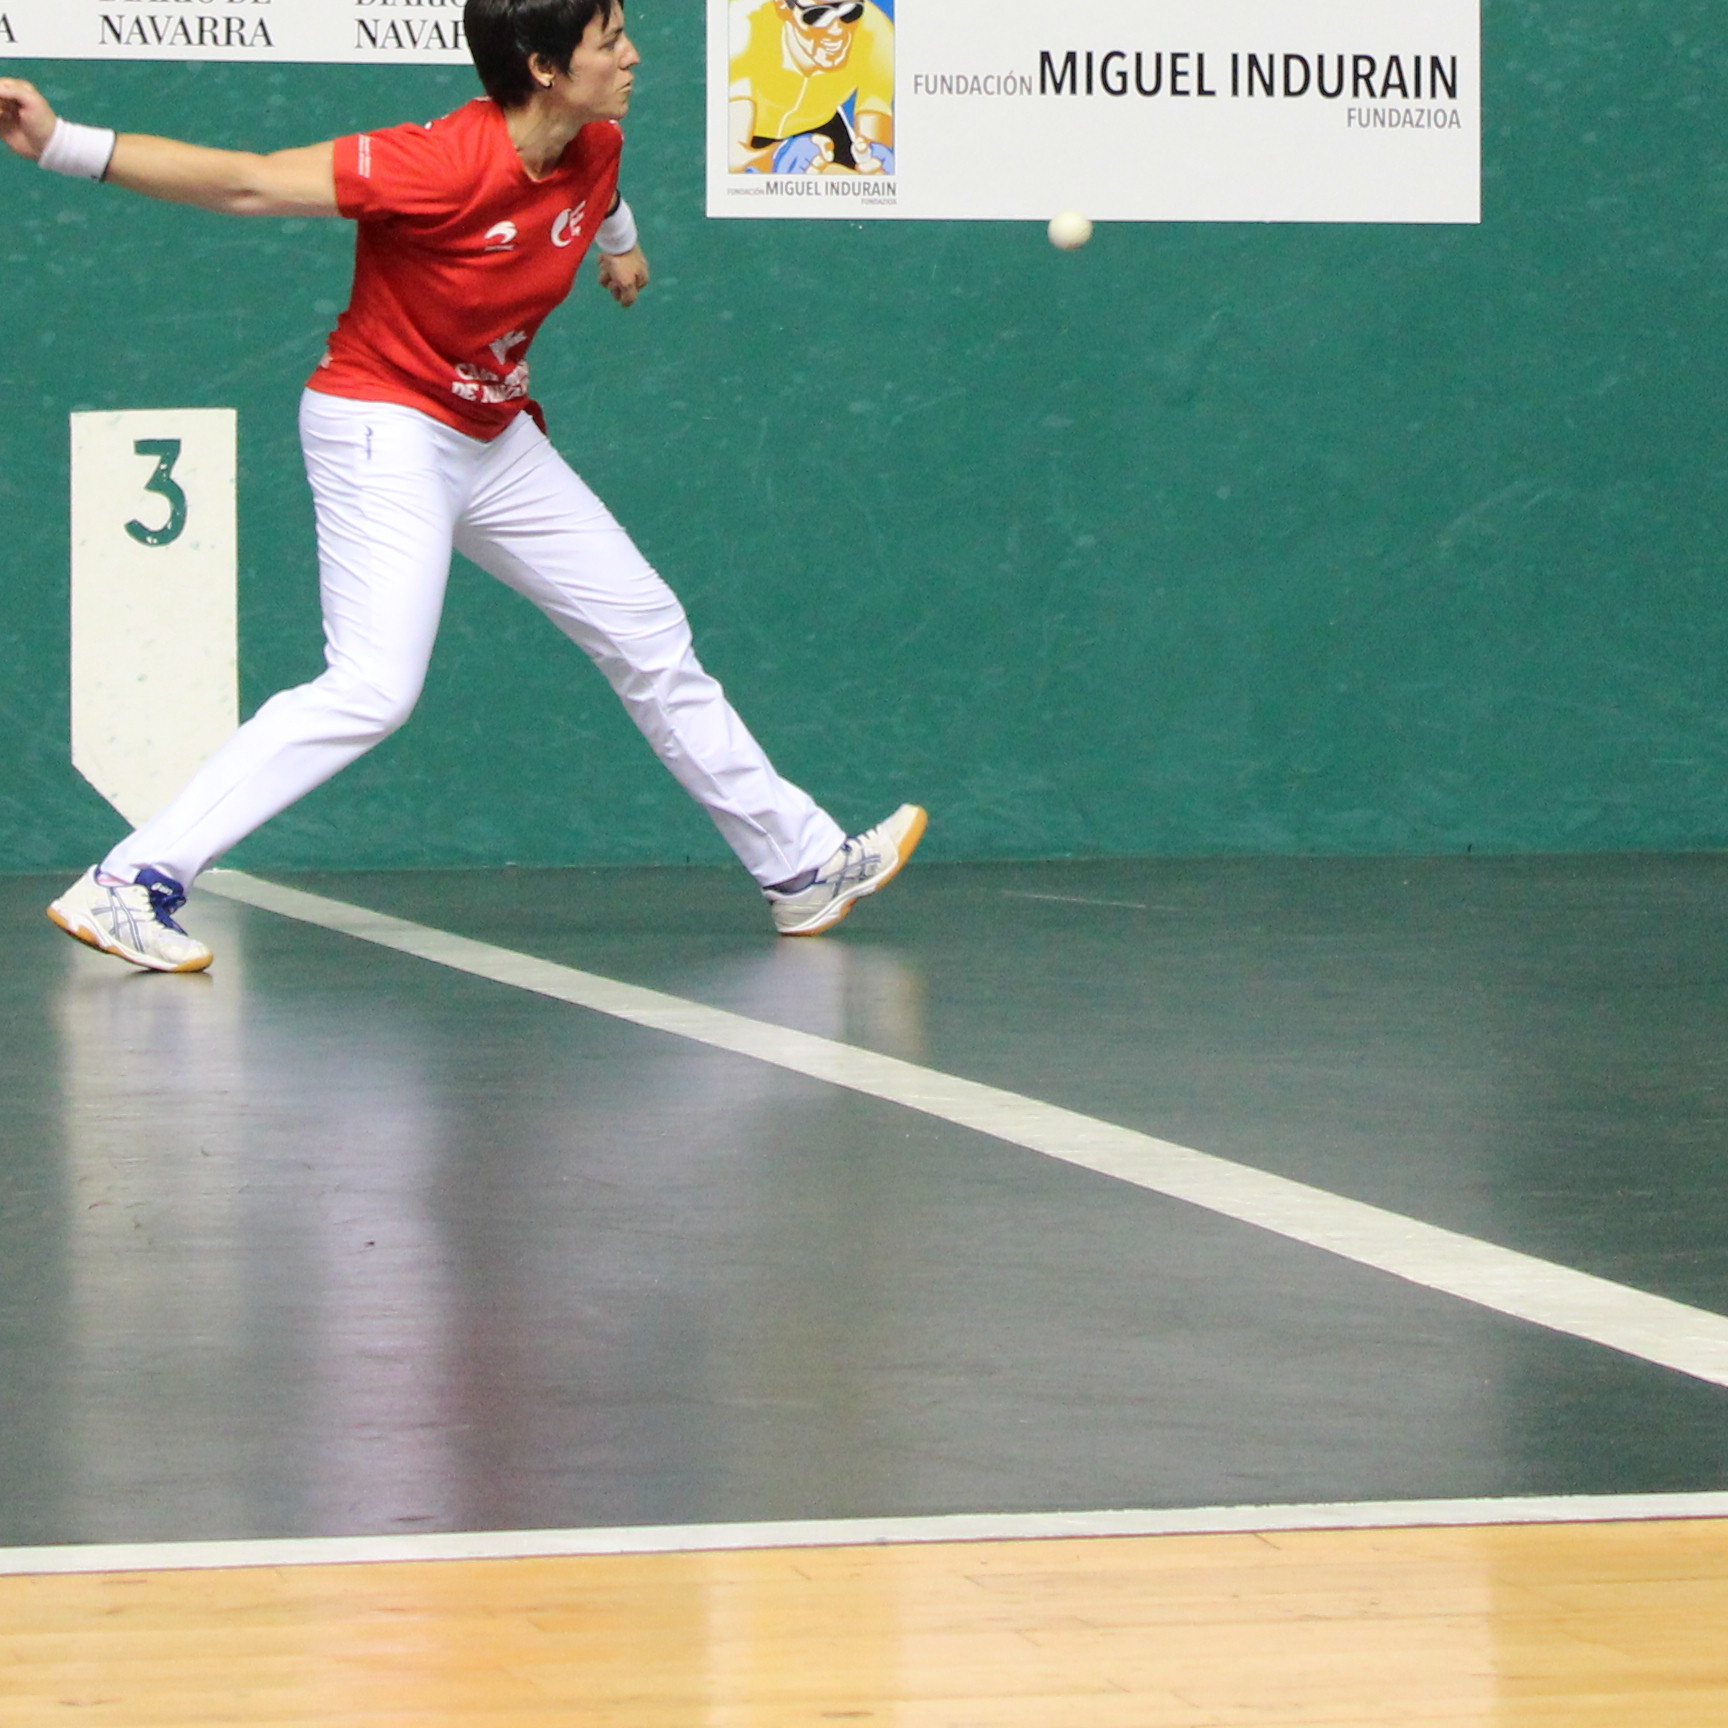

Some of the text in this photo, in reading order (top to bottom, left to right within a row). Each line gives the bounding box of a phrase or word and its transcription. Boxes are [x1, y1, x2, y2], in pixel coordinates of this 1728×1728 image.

[101, 15, 273, 46] NAVARRA
[914, 51, 1456, 99] FUNDACIÓN MIGUEL INDURAIN
[1347, 108, 1461, 129] FUNDAZIOA
[766, 181, 821, 196] MIGUEL
[825, 182, 896, 196] INDURAIN
[124, 439, 187, 547] 3
